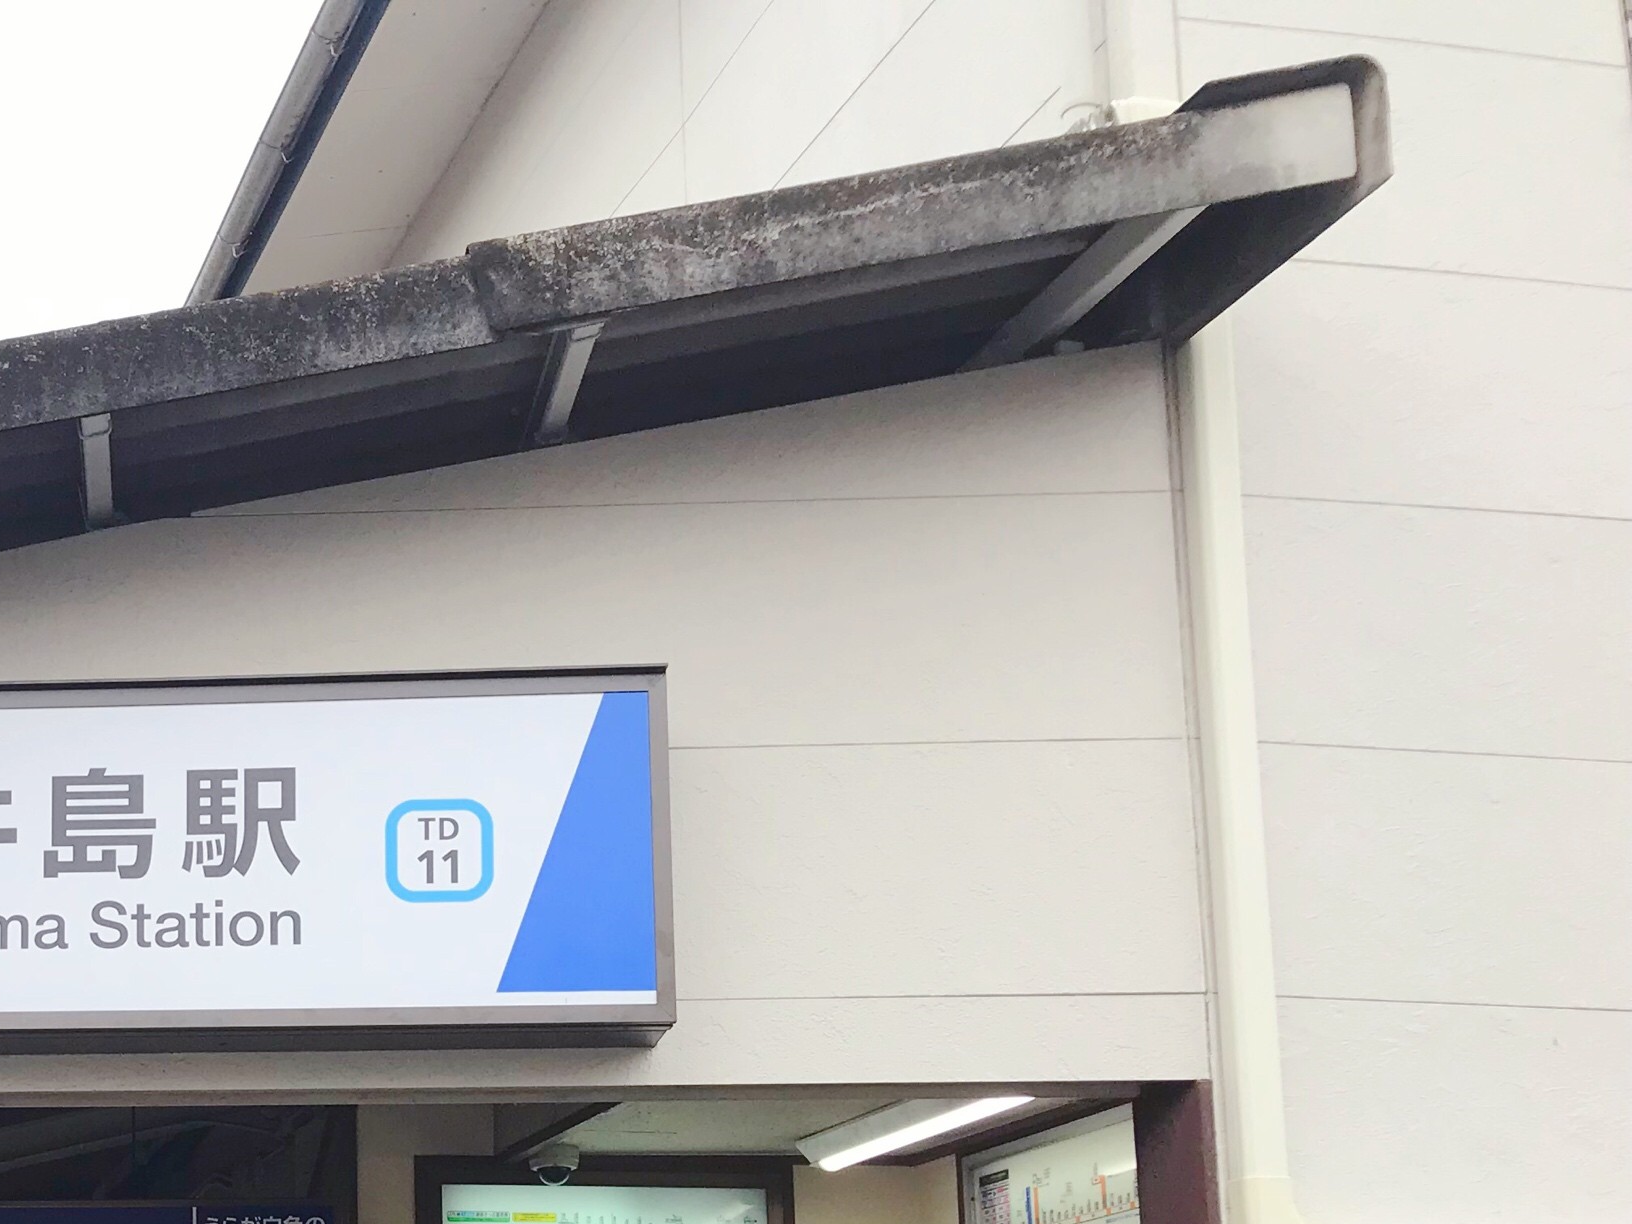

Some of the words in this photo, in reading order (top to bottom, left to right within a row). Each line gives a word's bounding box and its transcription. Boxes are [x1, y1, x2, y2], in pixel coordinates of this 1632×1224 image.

[418, 817, 460, 840] TD
[417, 850, 461, 884] 11
[90, 899, 305, 951] Station
